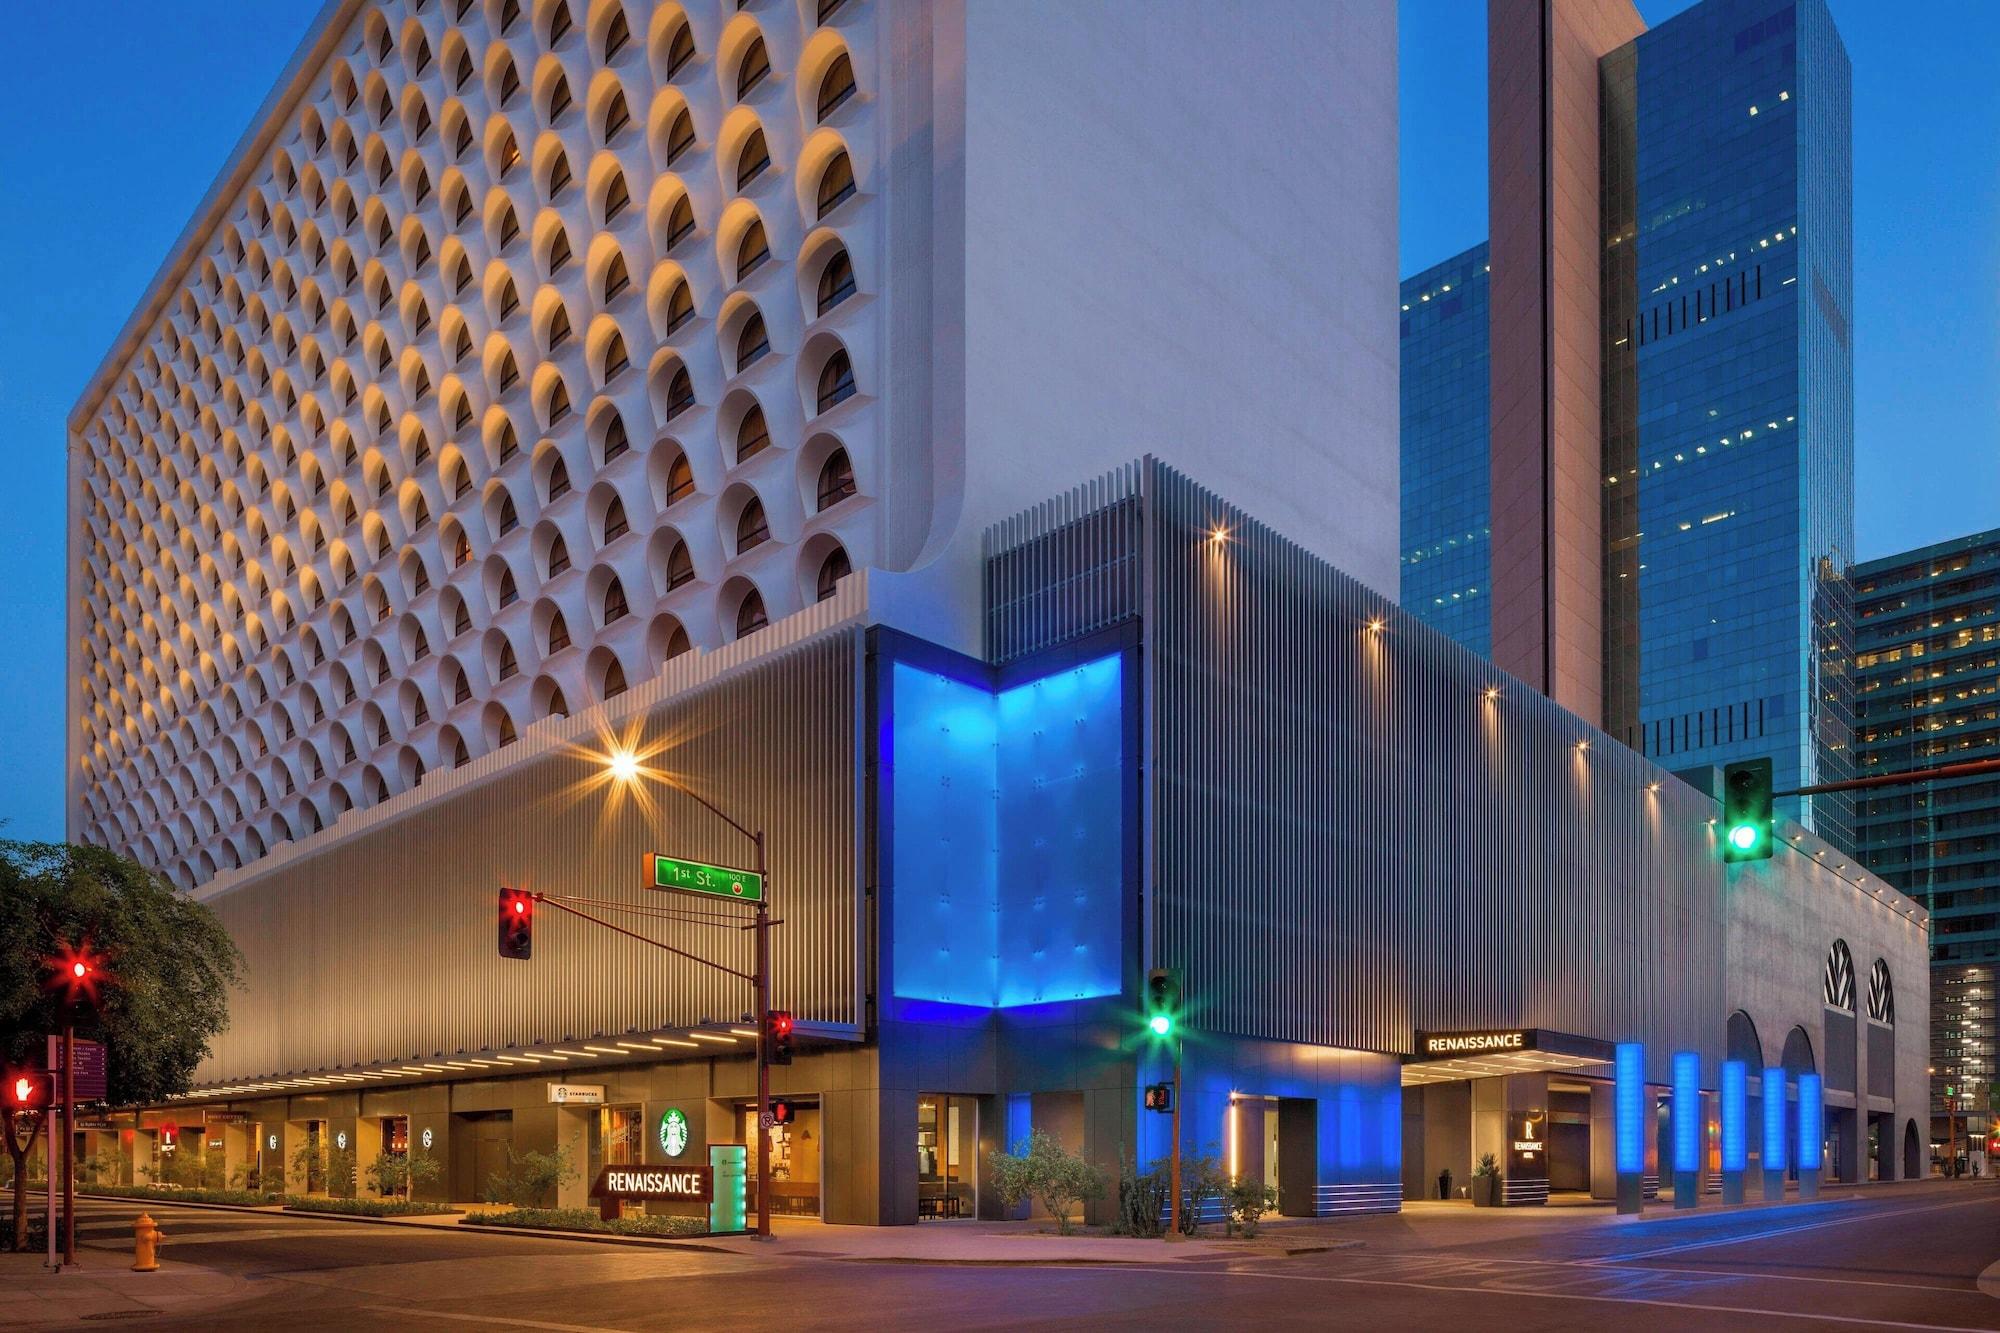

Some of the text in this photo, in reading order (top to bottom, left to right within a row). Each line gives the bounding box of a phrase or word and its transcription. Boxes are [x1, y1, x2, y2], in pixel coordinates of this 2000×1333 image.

[673, 866, 716, 887] 1st St.
[728, 873, 741, 882] 100
[1428, 1033, 1523, 1052] RENAISSANCE
[1514, 1141, 1543, 1151] RENAISSANCE
[607, 1171, 701, 1195] RENAISSANCE
